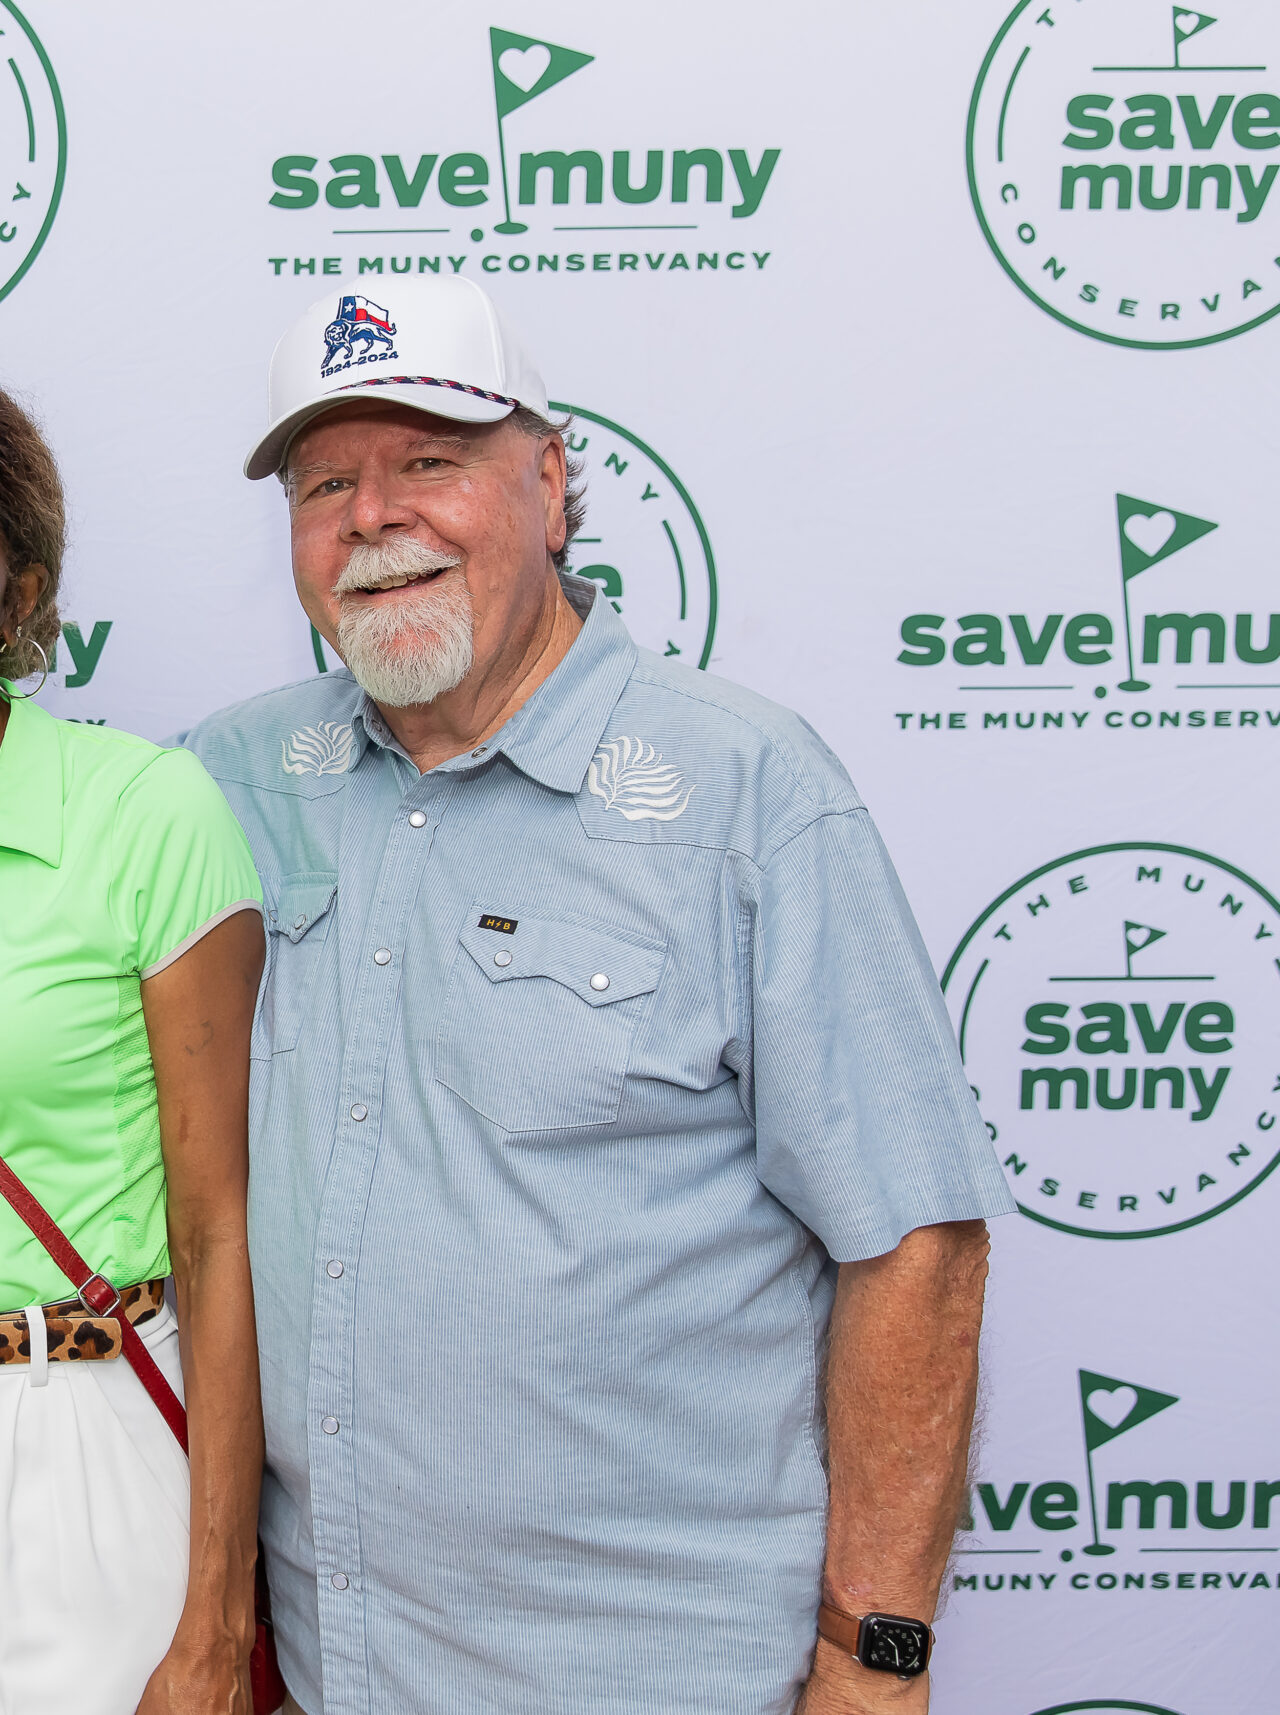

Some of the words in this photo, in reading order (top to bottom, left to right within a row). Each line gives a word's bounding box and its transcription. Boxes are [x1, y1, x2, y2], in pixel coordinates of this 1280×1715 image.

[1062, 93, 1280, 150] save
[268, 154, 490, 210] save
[518, 149, 782, 218] muny
[1060, 164, 1280, 223] muny
[268, 257, 342, 276] THE
[358, 255, 466, 274] MUNY
[481, 252, 771, 273] CONSERVANCY
[1001, 183, 1280, 321] CONSERVA
[897, 613, 1115, 666] save
[896, 713, 967, 729] THE
[983, 711, 1089, 729] MUNY
[994, 876, 1089, 941] THE
[1137, 866, 1273, 940] MUNY
[1022, 1002, 1235, 1055] save
[1020, 1067, 1232, 1122] muny
[953, 1574, 1057, 1591] MUNY
[1071, 1573, 1280, 1590] CONSERVA
